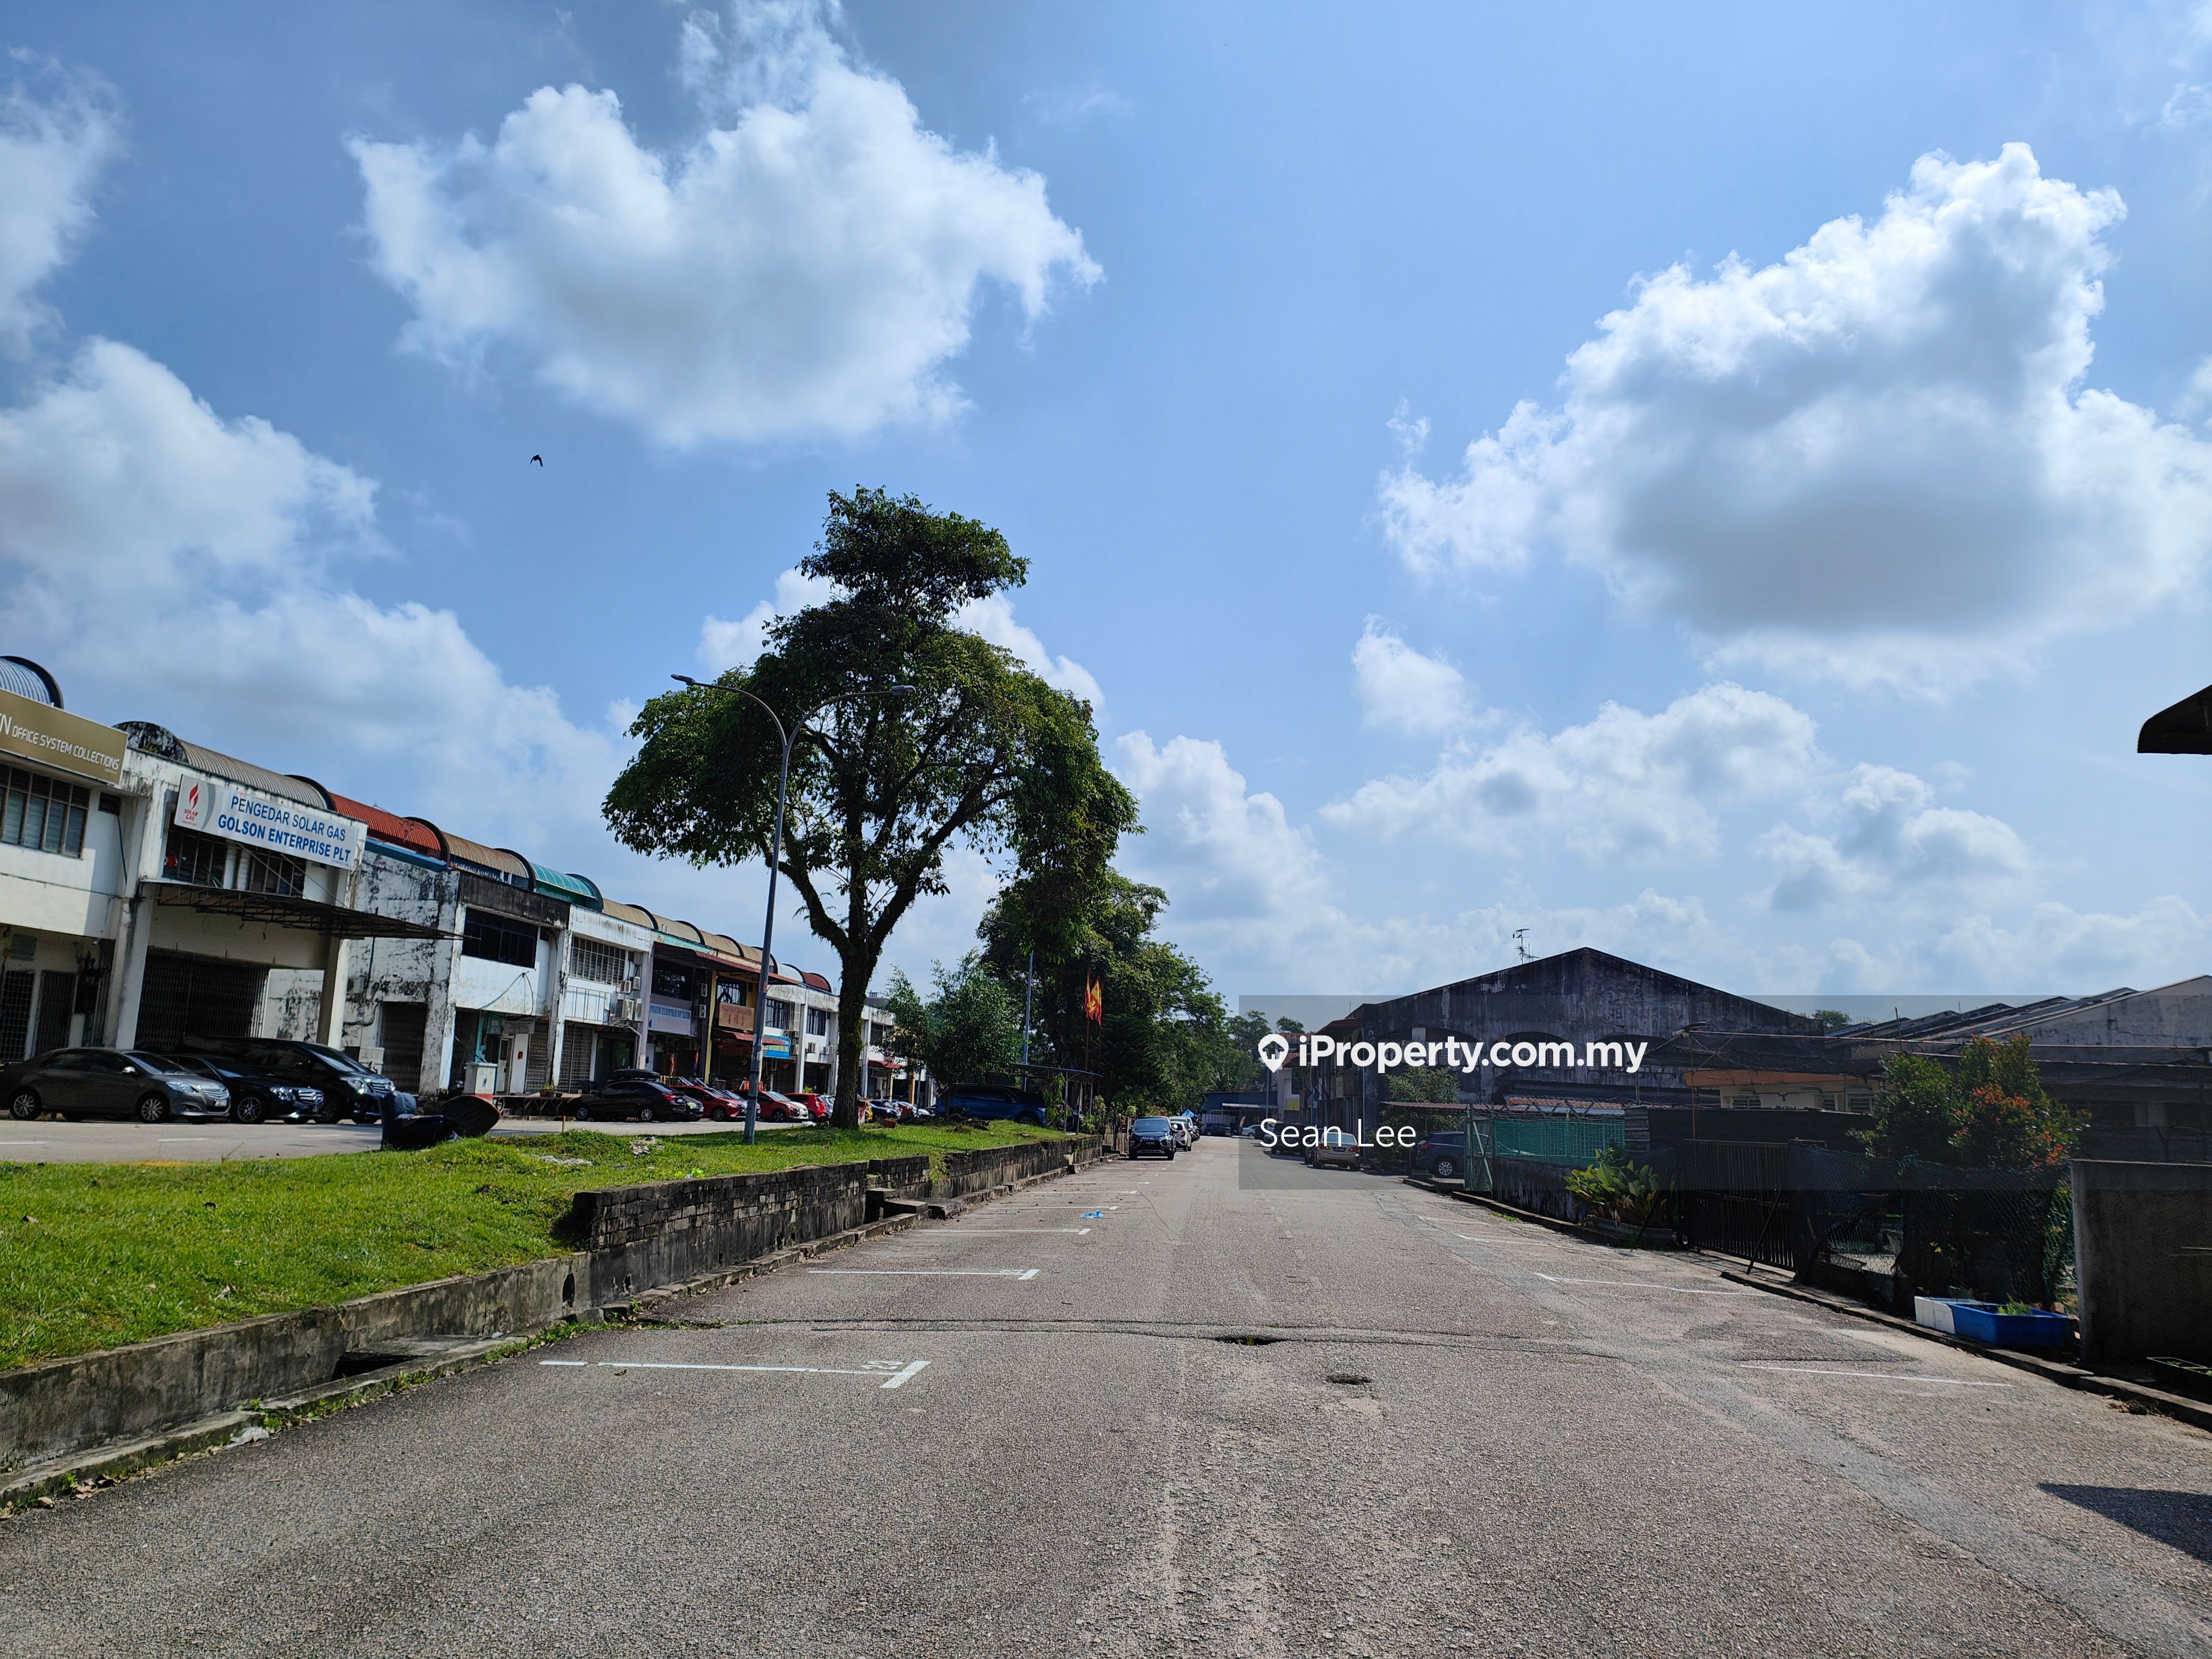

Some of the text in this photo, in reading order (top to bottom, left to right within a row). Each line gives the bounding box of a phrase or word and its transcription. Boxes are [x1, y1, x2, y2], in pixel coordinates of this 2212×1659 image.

[0, 713, 120, 770] N OFFICE SYSTEM COLLECTIONS
[218, 814, 350, 862] GOLSON ENTERPRISE PLT
[231, 795, 346, 841] PENGEDAR SOLAR GAS
